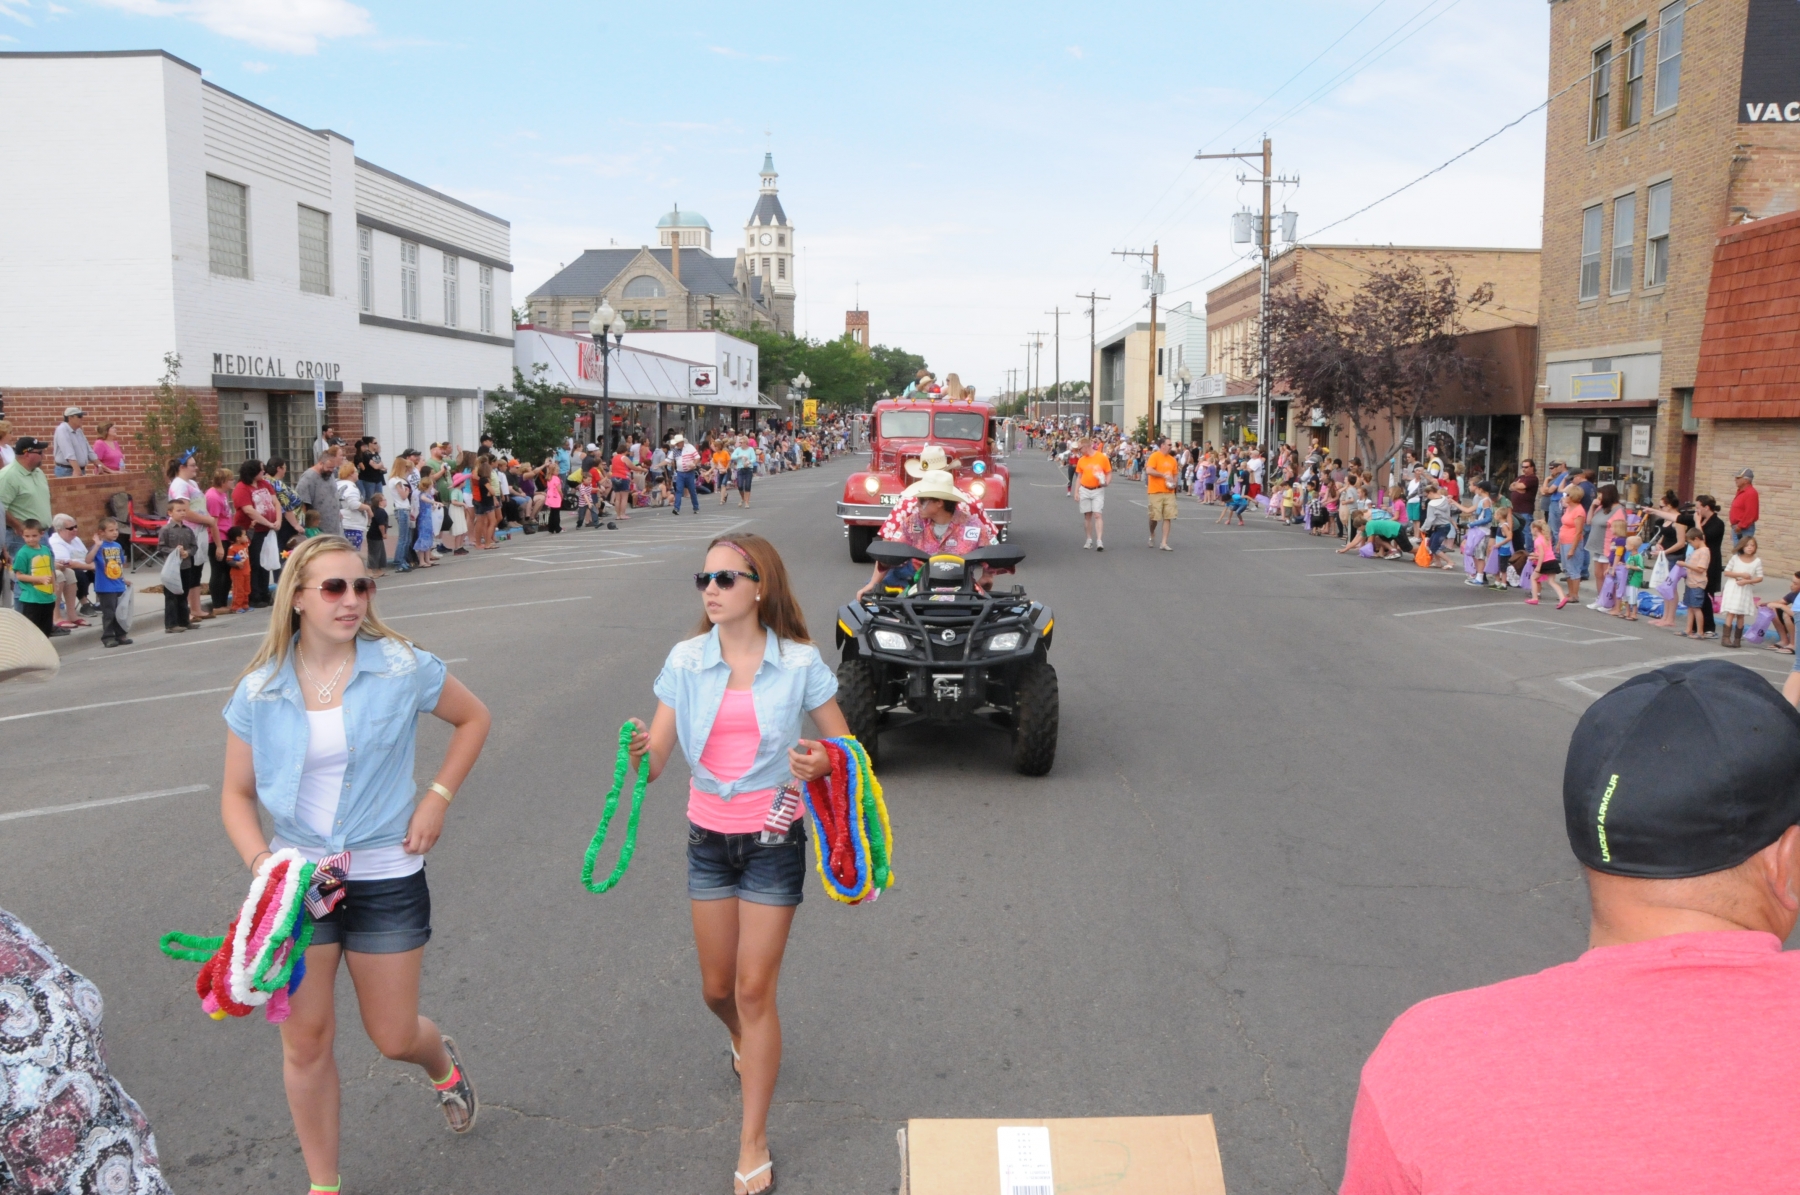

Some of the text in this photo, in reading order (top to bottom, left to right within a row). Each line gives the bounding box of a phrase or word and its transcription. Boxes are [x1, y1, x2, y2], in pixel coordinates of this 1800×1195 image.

[1746, 102, 1800, 121] VAC
[213, 353, 340, 380] MEDICAL GROUP
[1597, 774, 1619, 862] UNDER ARMOUR
